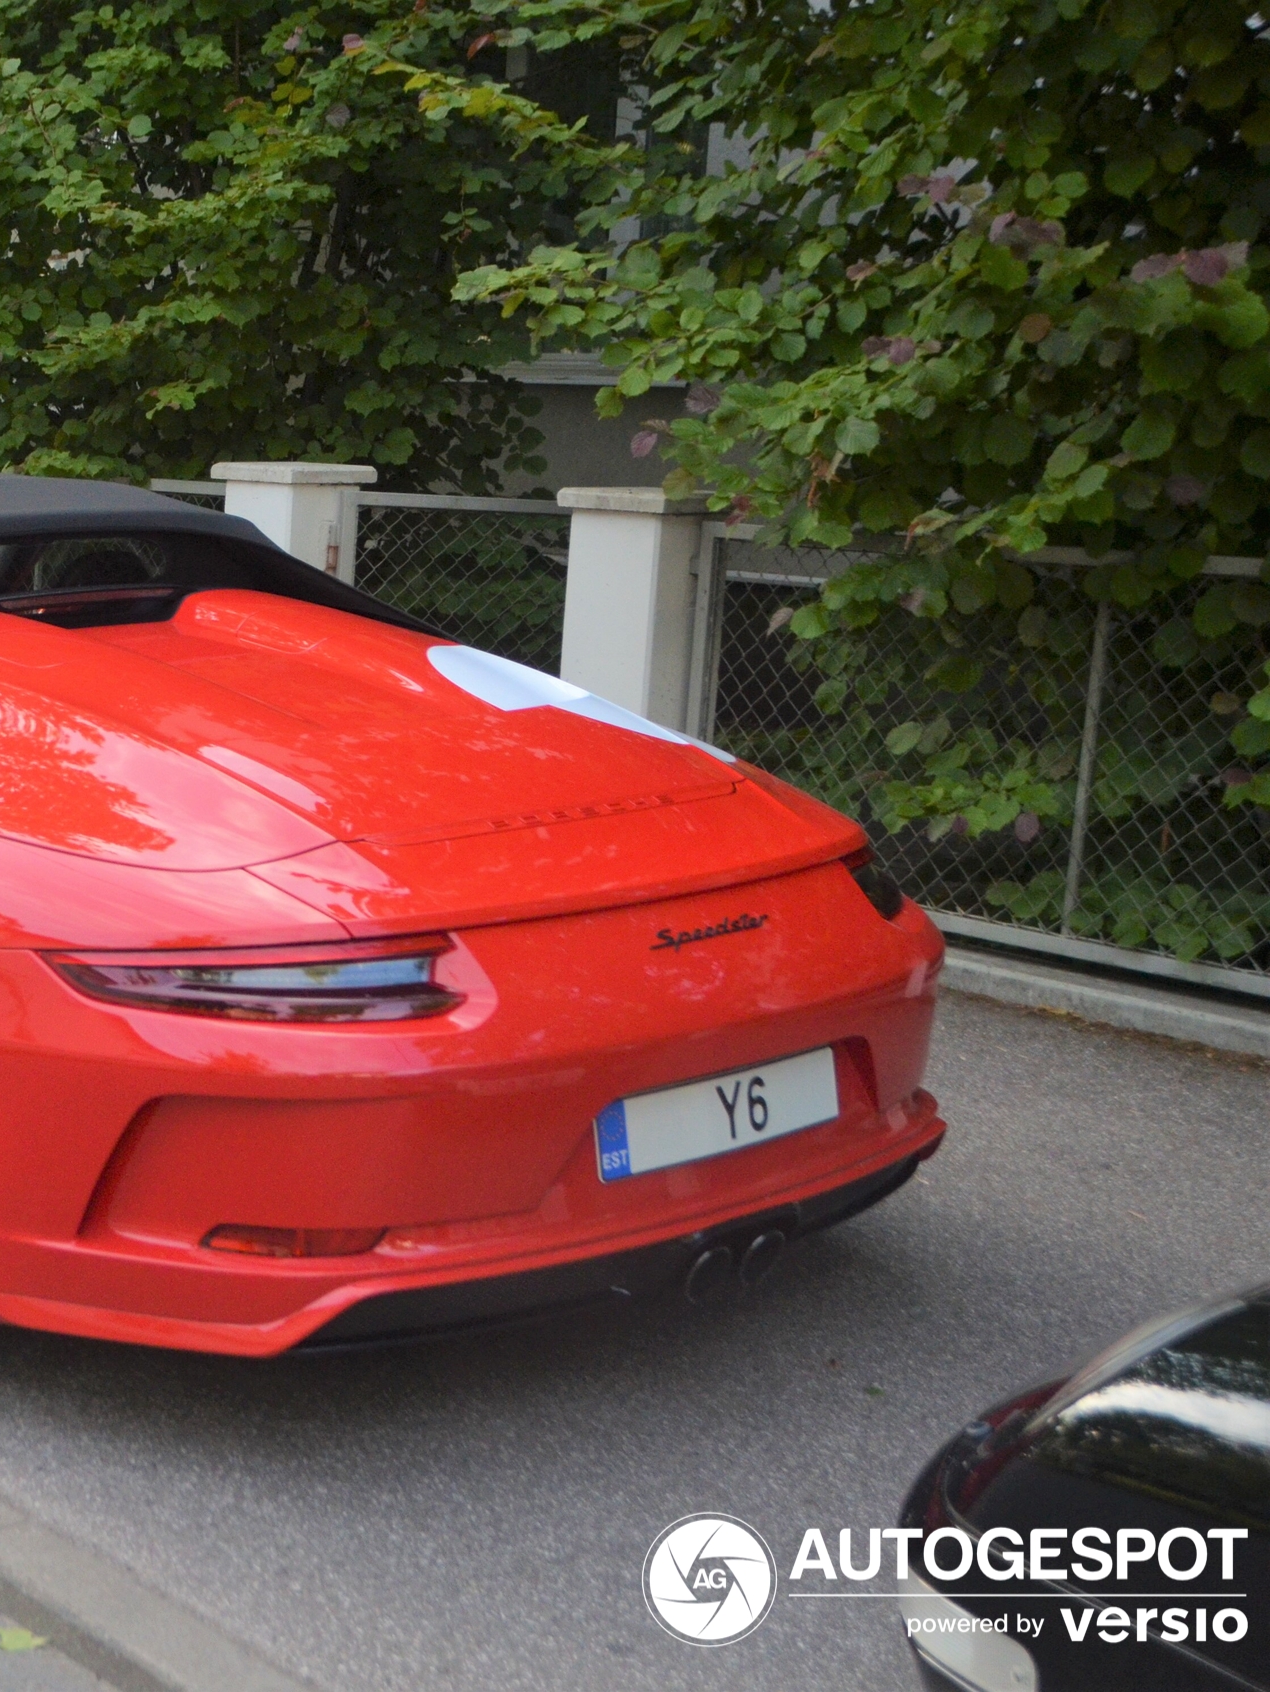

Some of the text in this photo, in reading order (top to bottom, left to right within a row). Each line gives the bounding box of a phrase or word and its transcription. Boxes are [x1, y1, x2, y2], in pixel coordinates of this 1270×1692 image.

[648, 913, 769, 953] Speedster
[714, 1075, 769, 1139] Y6
[602, 1148, 628, 1171] EST
